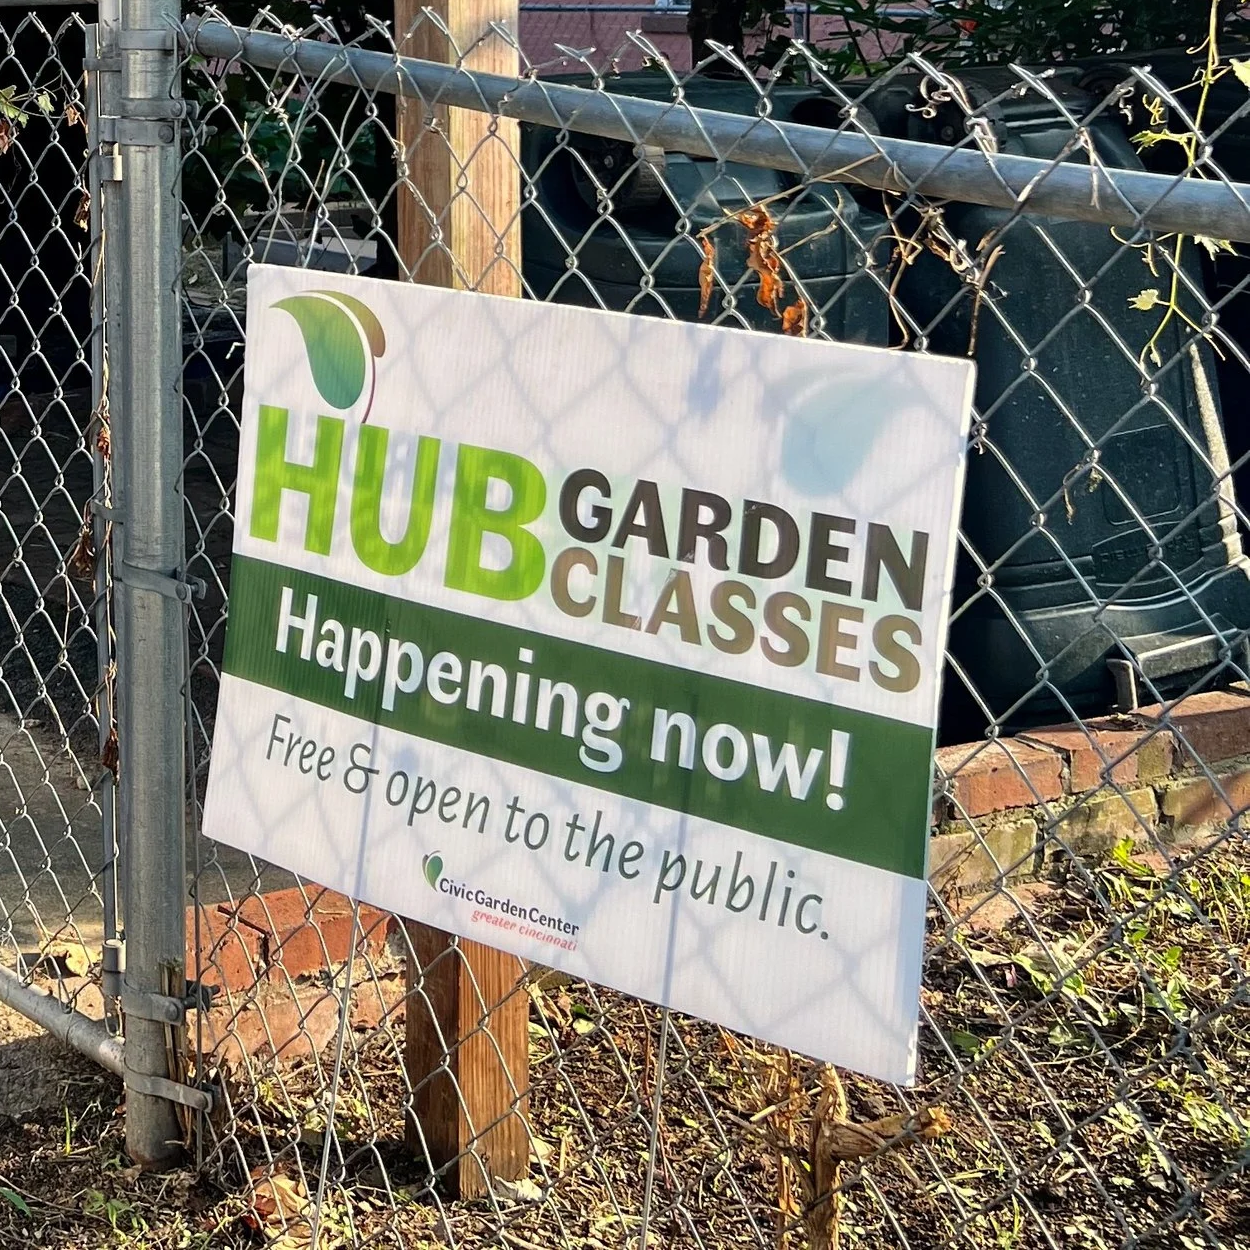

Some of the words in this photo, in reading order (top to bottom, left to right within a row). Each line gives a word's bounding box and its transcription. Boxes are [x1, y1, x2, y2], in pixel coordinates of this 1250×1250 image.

[250, 404, 547, 601] HUB
[559, 468, 929, 612] GARDEN
[275, 586, 630, 773] Happening
[650, 708, 850, 811] now!
[551, 547, 922, 693] CLASSES
[266, 713, 335, 781] Free
[343, 743, 380, 794] &
[385, 769, 491, 834] open
[504, 796, 550, 851] to
[564, 810, 645, 879] the
[653, 849, 829, 940] public.
[471, 909, 517, 931] greater
[518, 925, 579, 952] cincinnati
